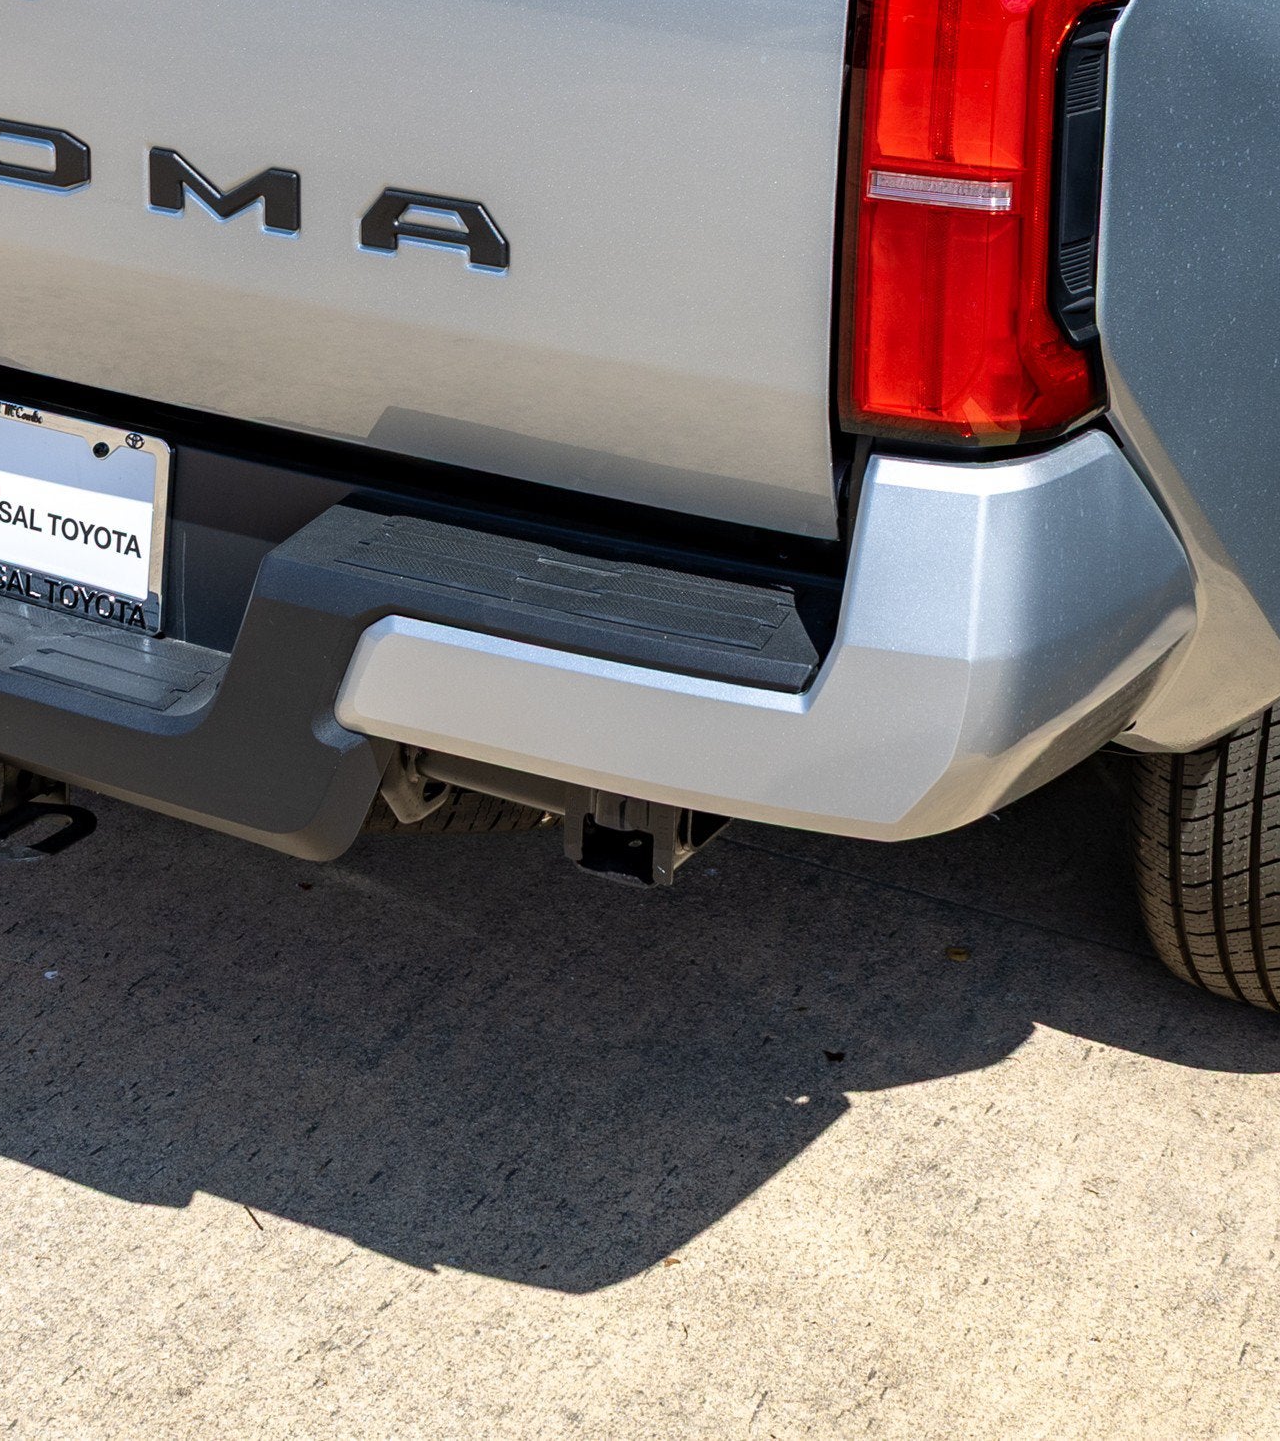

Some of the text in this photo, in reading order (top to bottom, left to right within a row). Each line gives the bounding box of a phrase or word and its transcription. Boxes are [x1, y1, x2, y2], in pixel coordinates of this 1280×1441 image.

[1, 402, 43, 425] McCombs
[47, 513, 142, 559] TOYOTA
[43, 578, 148, 630] TOYOTA
